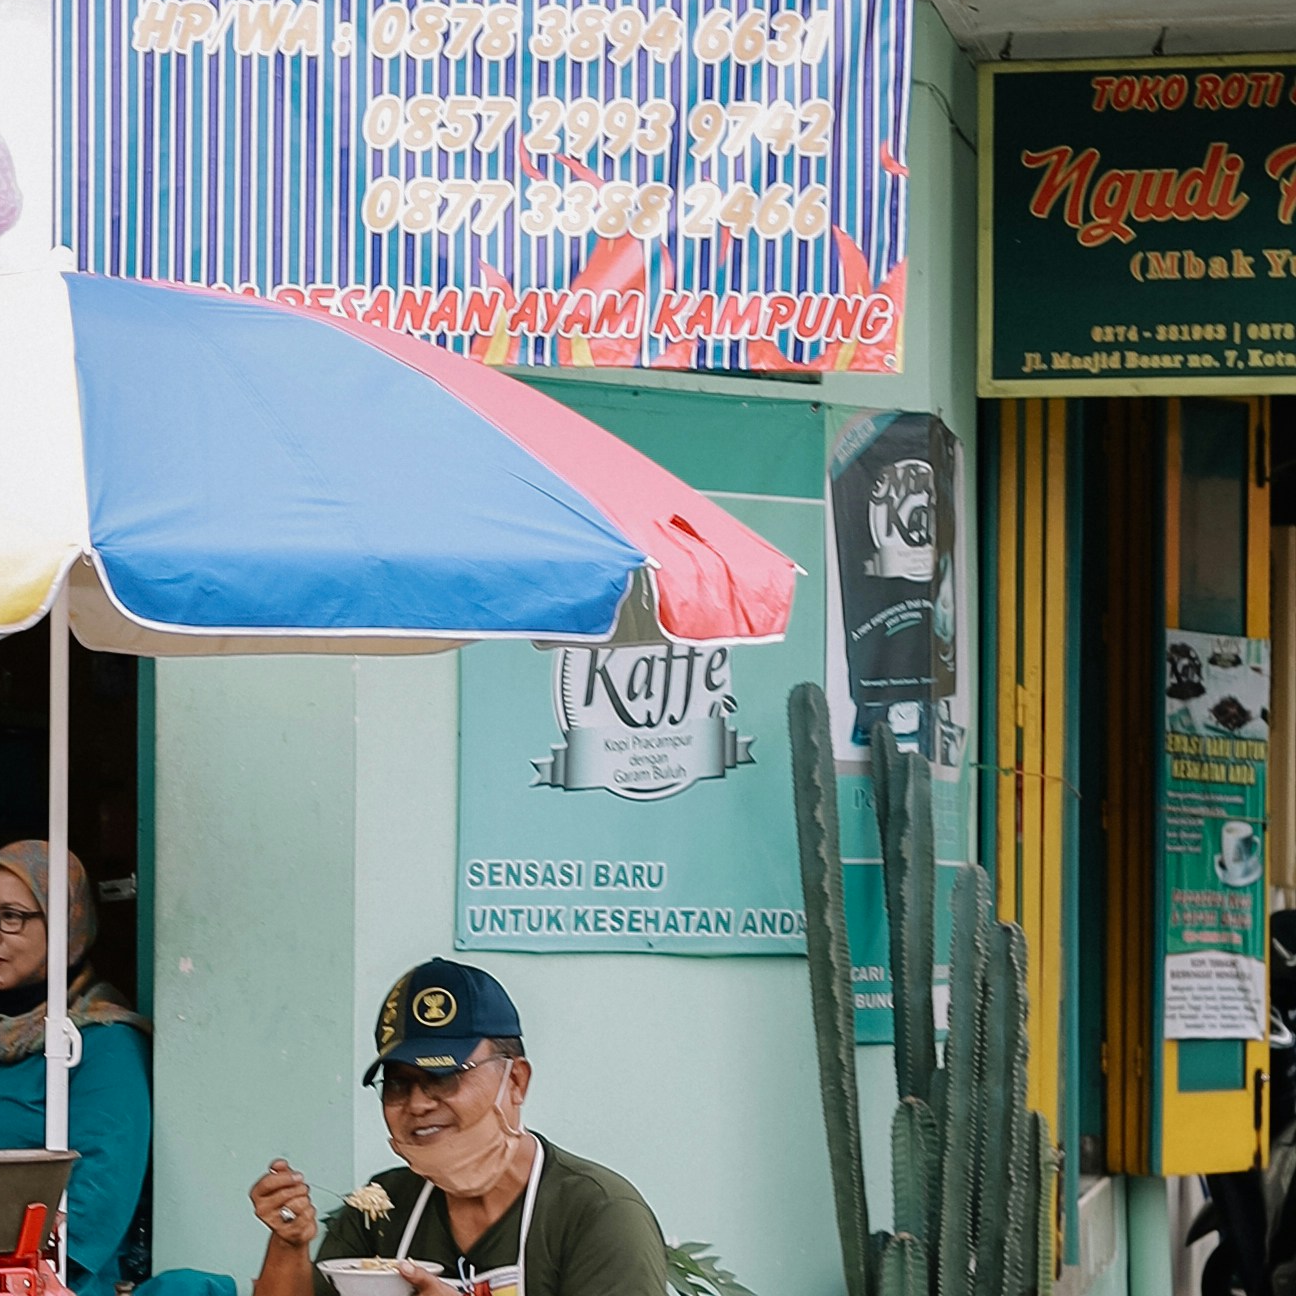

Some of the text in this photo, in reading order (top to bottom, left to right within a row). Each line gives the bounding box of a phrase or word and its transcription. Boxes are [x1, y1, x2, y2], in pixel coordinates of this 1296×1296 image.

[373, 1, 520, 61] 0878
[529, 3, 680, 65] 3894
[694, 6, 829, 67] 6631
[1091, 75, 1187, 112] TOKO
[1194, 72, 1285, 110] ROTI
[363, 94, 833, 160] 0857 2993 9742
[362, 177, 828, 240] 0877 3388 2466
[1020, 142, 1250, 248] Ngudi
[1130, 249, 1255, 282] (Mbak
[508, 289, 643, 342] AYAM
[650, 291, 894, 345] KAMPUNG
[604, 737, 630, 754] Kopi
[629, 753, 670, 767] dengan
[613, 765, 687, 784] Garam Buluh
[467, 860, 667, 891] SENSASI BARU
[469, 906, 565, 935] UNTUK
[573, 906, 732, 936] KESEHATAN
